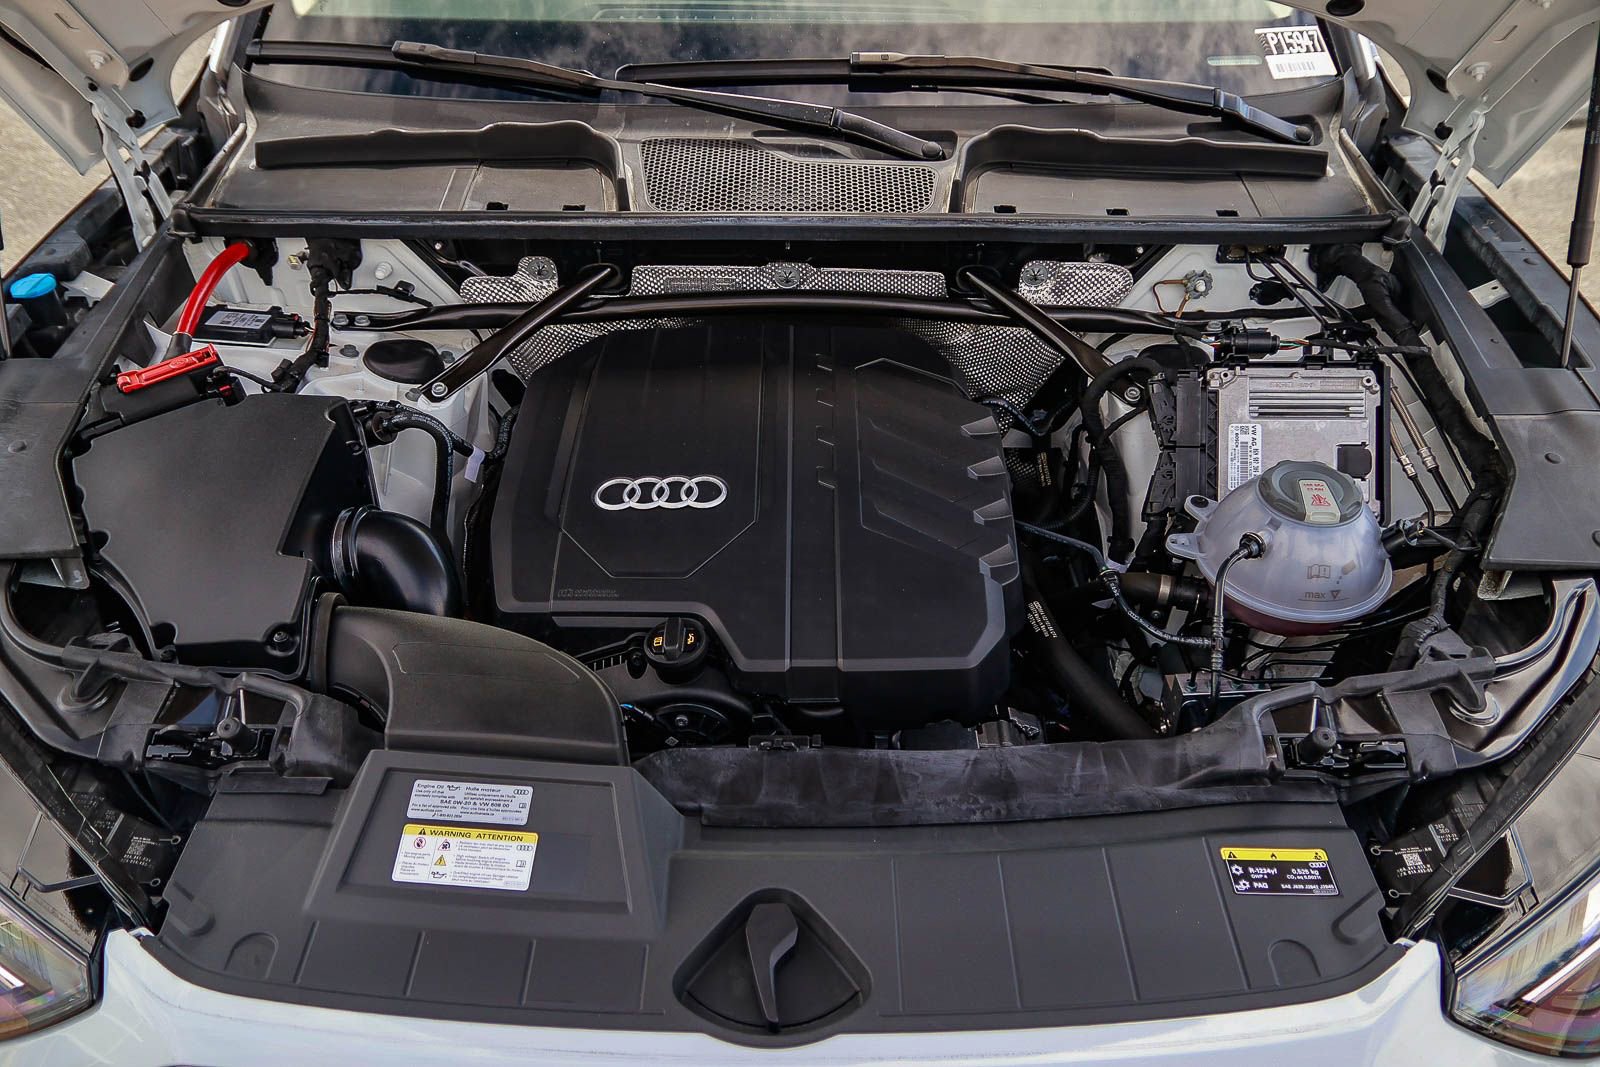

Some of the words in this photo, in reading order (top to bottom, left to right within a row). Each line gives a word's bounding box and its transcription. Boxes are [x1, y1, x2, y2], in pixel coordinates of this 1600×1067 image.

[1266, 30, 1322, 55] P15947
[1251, 425, 1257, 436] VW
[1251, 437, 1257, 447] AG
[1304, 591, 1326, 599] max
[430, 830, 472, 838] WARNING
[476, 832, 524, 842] ATTENTION
[1248, 866, 1278, 876] R-1234yf
